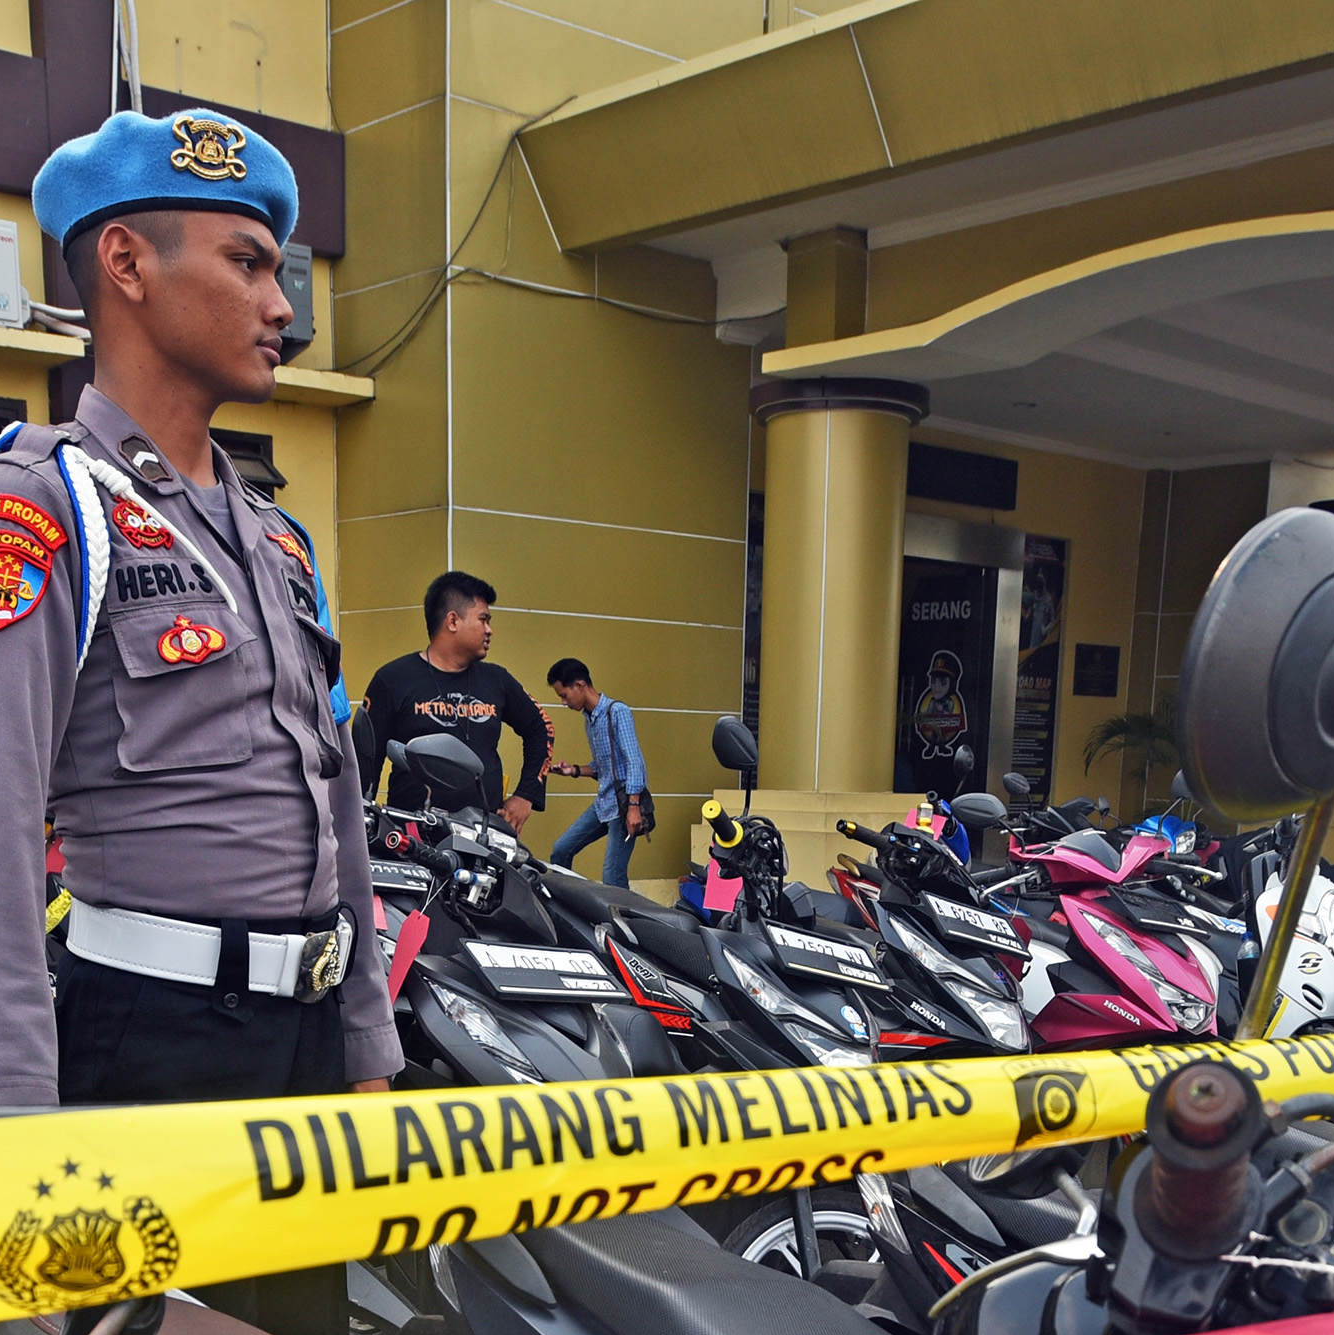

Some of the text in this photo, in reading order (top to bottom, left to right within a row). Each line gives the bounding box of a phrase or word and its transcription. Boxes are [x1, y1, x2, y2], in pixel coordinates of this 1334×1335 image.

[2, 500, 60, 543] PROPAM
[117, 563, 213, 602] HERI.S
[911, 599, 971, 622] SERANG
[909, 1000, 948, 1031] HONDA
[1102, 1000, 1142, 1026] HONDA
[245, 1061, 974, 1202] DILARANG MELINTAS
[509, 1182, 656, 1233] NOT
